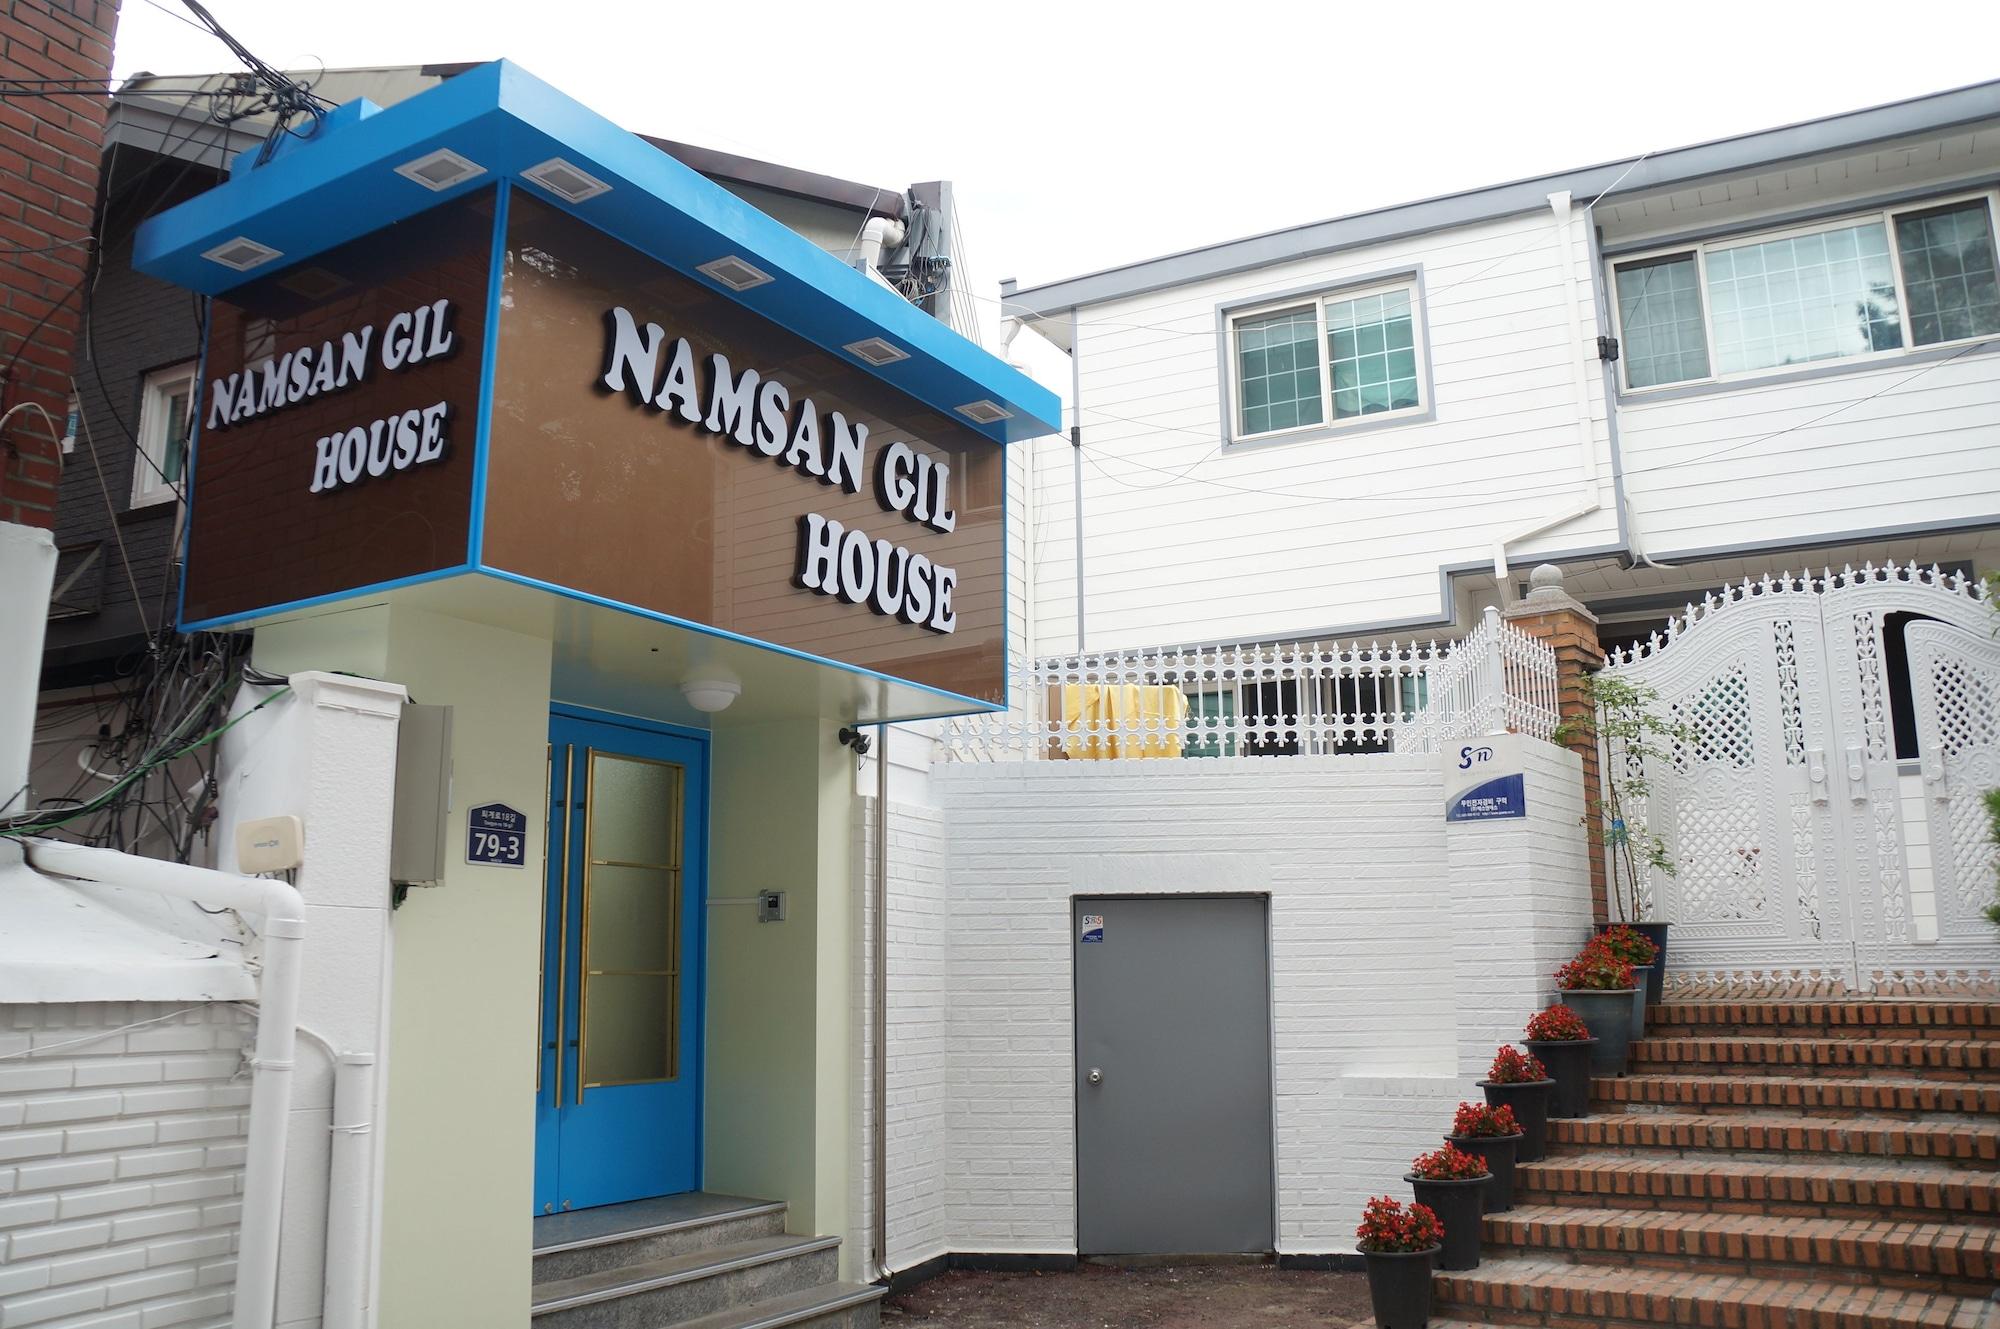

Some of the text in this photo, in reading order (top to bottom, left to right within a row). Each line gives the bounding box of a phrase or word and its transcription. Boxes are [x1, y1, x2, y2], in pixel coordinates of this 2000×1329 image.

[206, 299, 453, 429] NAMSAN GIL
[604, 306, 956, 533] NAMSAN GIL
[309, 401, 447, 493] HOUSE
[801, 512, 957, 634] HOUSE
[475, 833, 519, 860] 79-3
